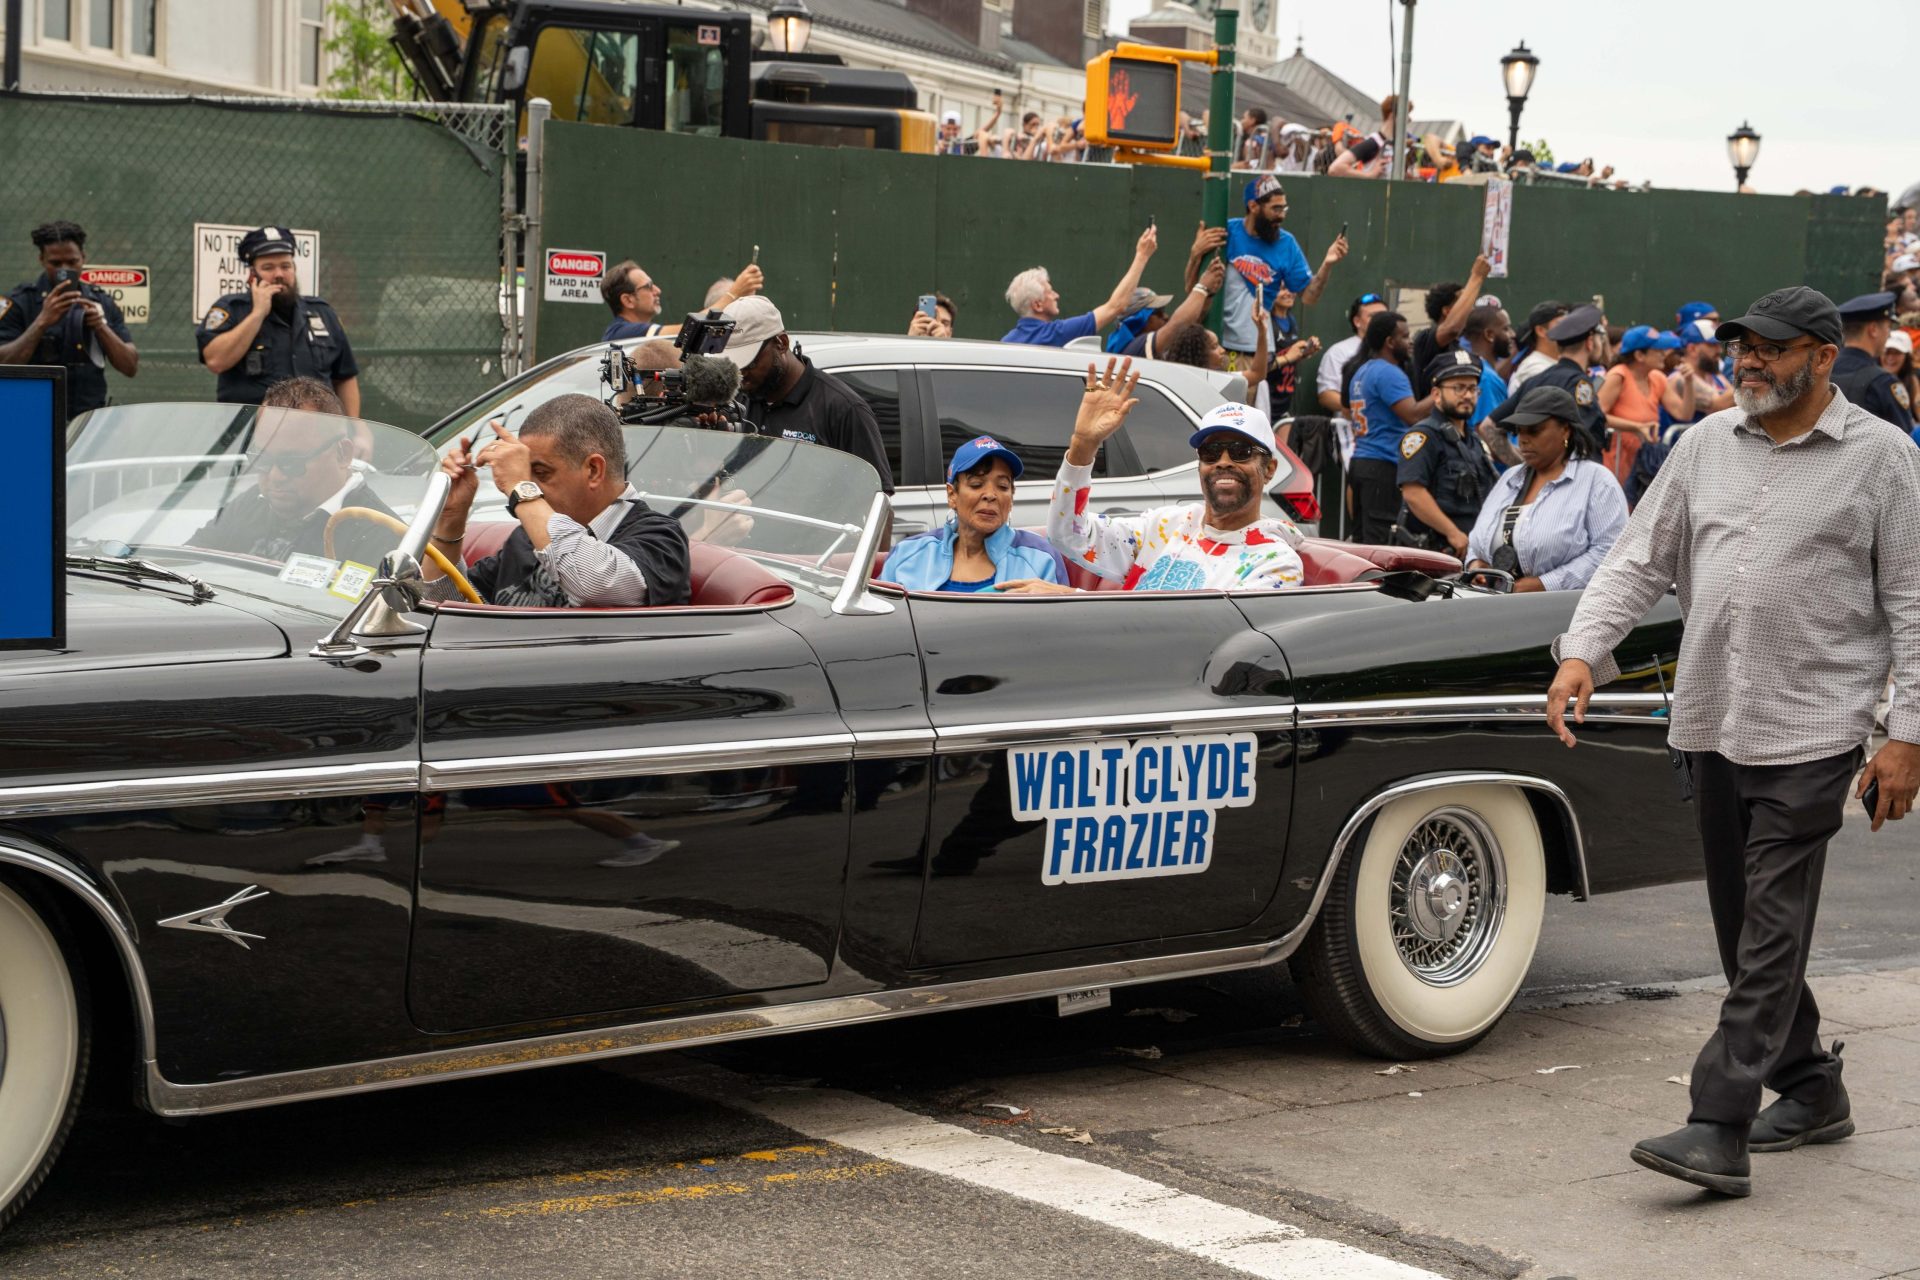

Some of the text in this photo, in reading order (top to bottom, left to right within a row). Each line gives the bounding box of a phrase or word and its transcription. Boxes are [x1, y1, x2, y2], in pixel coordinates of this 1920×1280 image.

[204, 234, 222, 252] NO
[553, 257, 599, 272] DANGER
[88, 271, 135, 282] DANGER
[549, 277, 600, 289] HARD HAT
[561, 288, 589, 298] AREA
[1015, 742, 1251, 812] WALT CLYDE
[1049, 809, 1210, 876] FRAZIER
